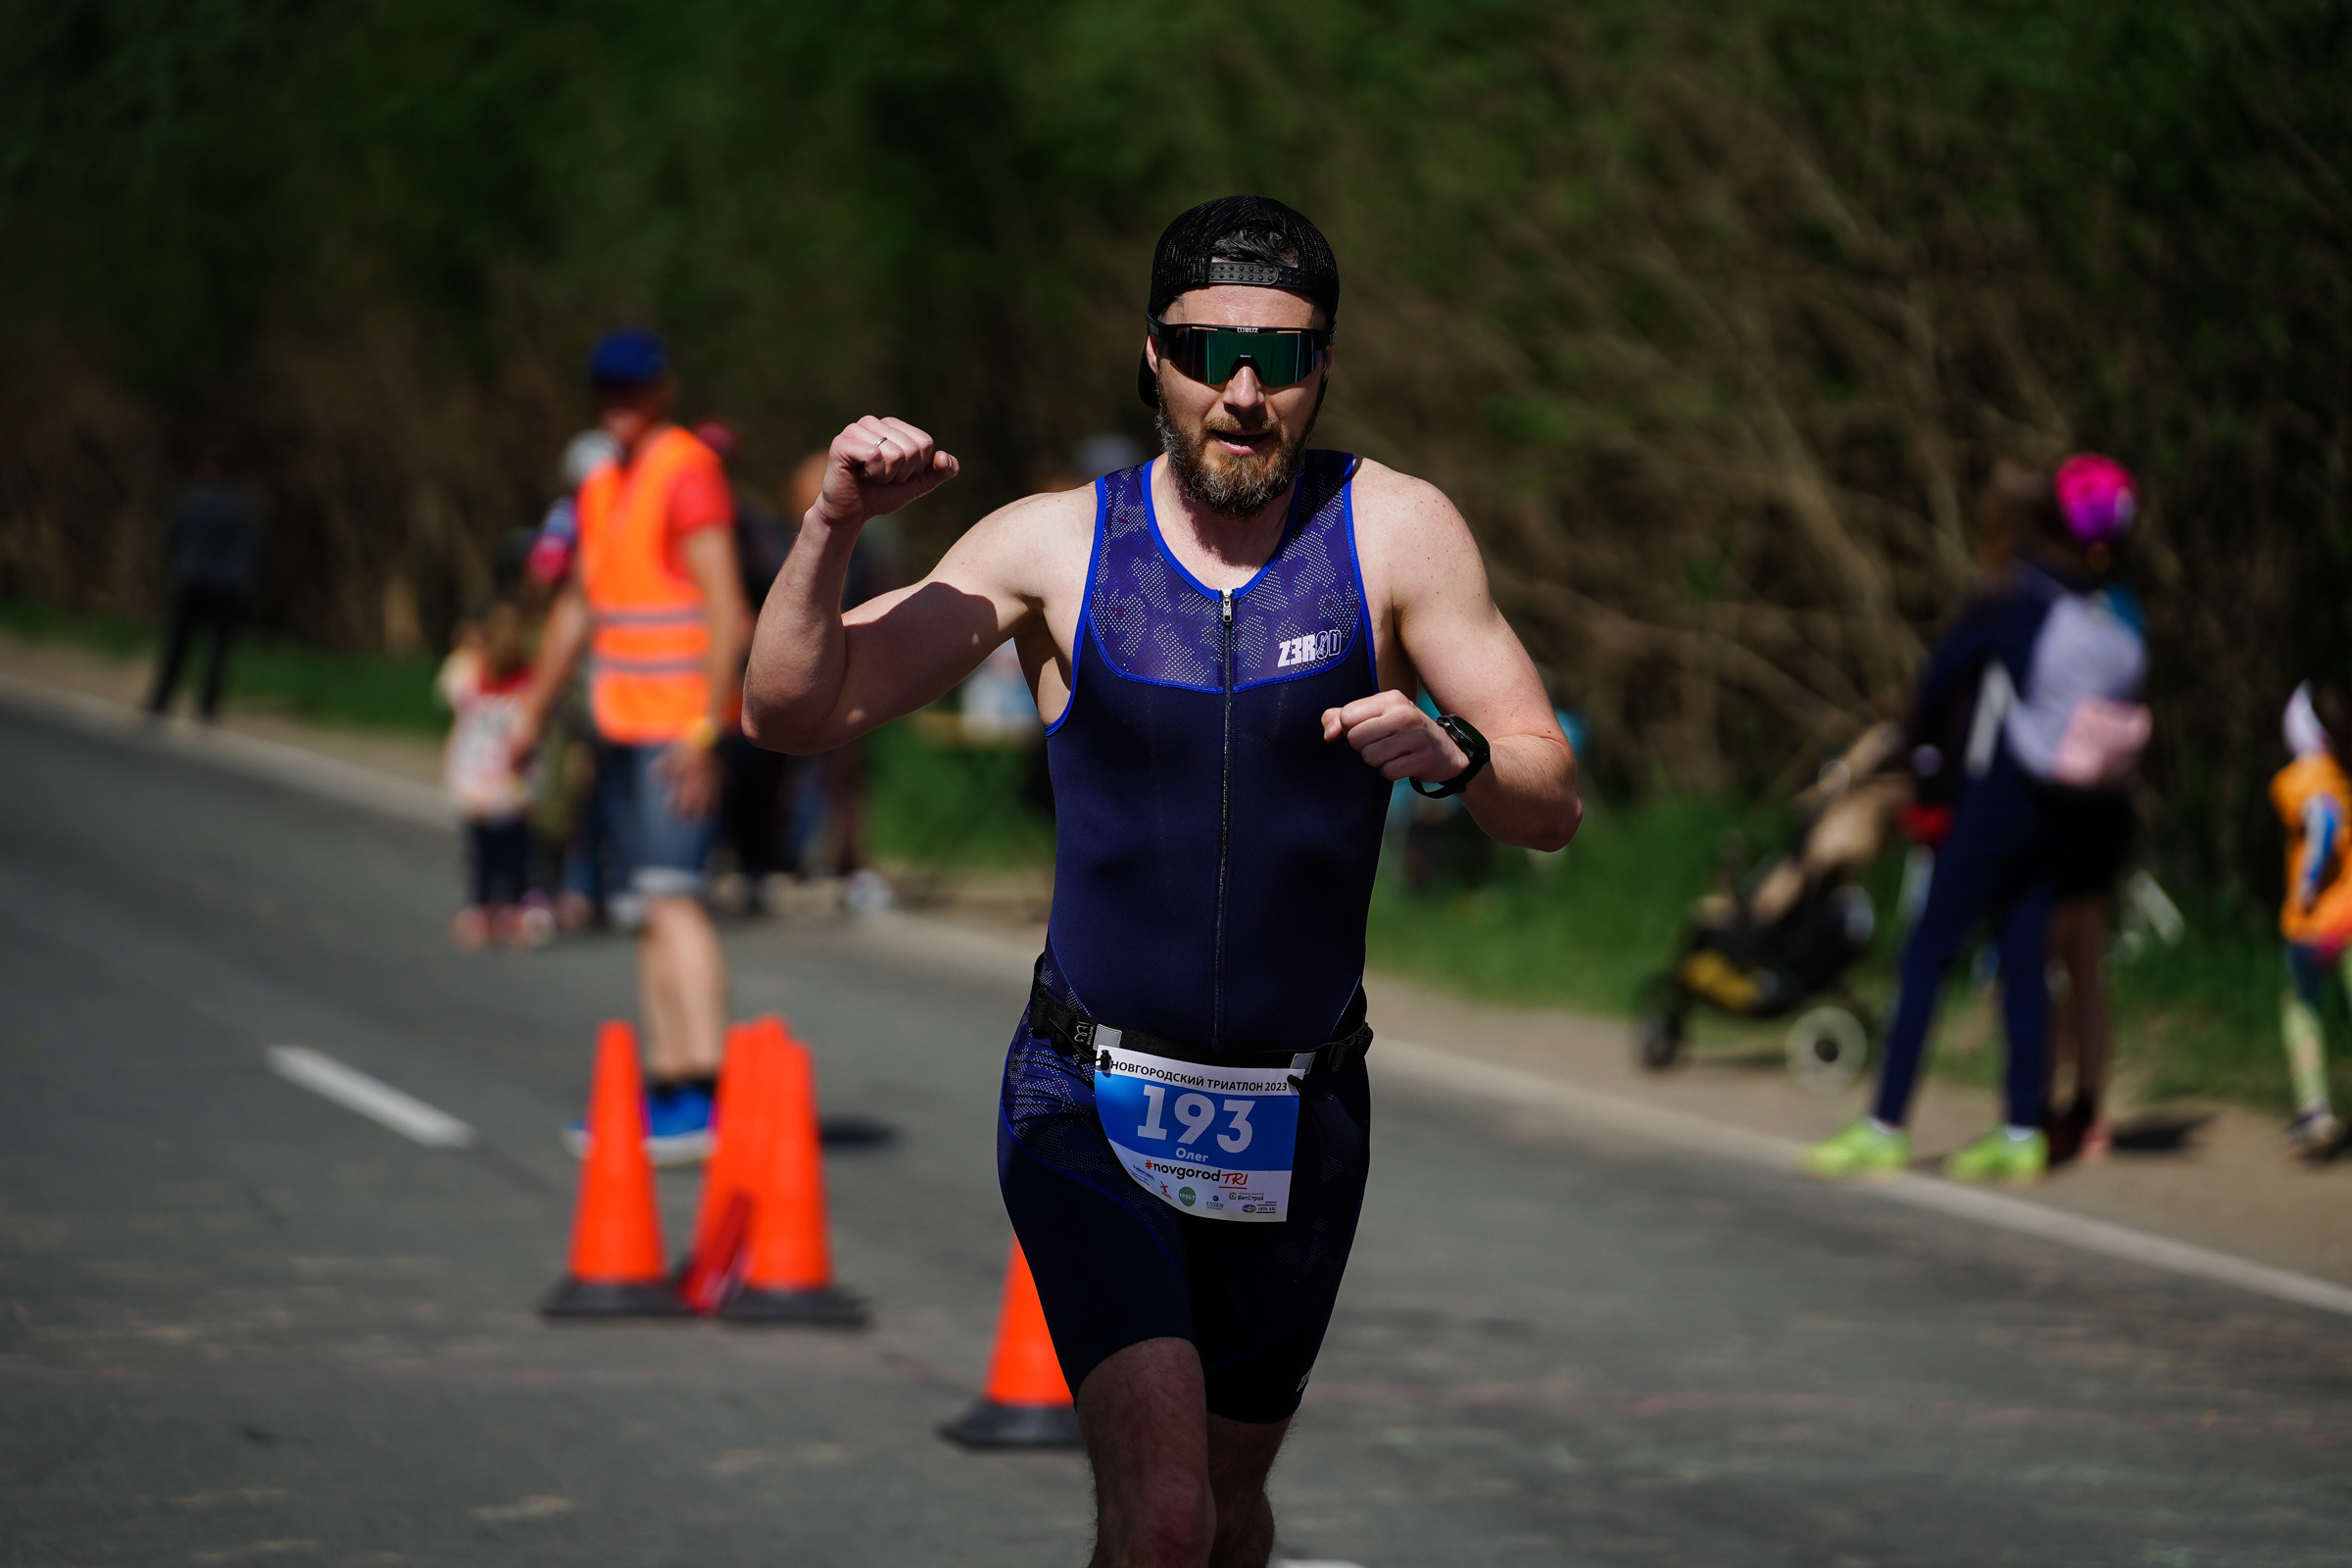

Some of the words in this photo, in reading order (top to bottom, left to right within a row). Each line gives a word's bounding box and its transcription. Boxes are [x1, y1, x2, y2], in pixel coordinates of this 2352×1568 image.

[1110, 1059, 1204, 1087] НОВГОРОДСКИЙ
[1207, 1078, 1263, 1092] ТРИАТЛОН
[1264, 1082, 1288, 1092] 2023
[1137, 1084, 1255, 1153] 193
[1175, 1147, 1209, 1163] Олег
